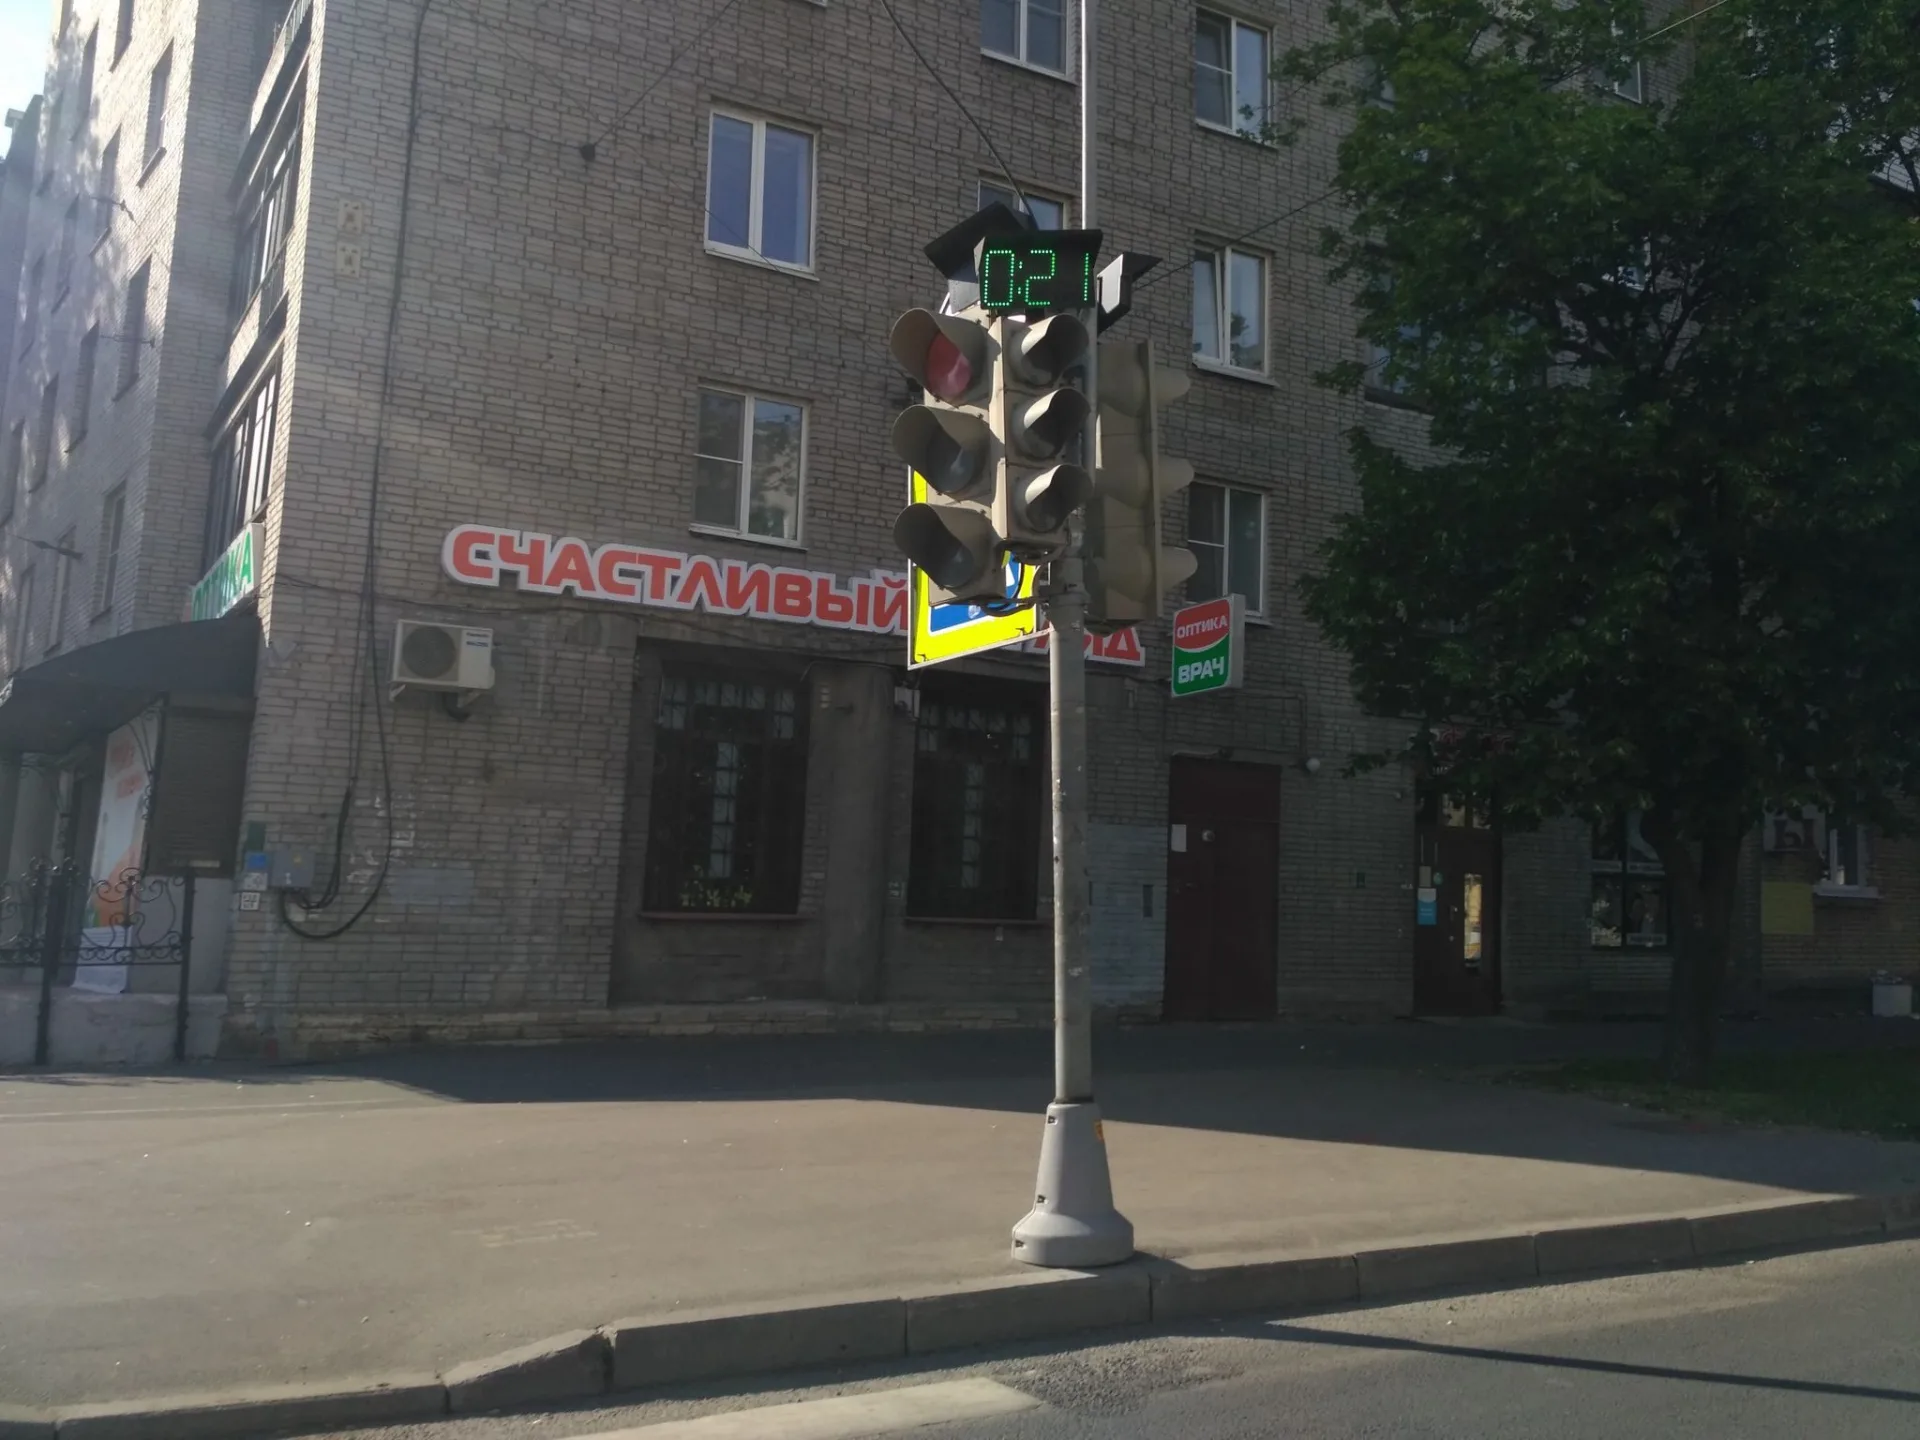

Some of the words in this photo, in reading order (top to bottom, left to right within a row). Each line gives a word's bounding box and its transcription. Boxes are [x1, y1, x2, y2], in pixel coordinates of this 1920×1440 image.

[450, 529, 909, 632] СЧАСТЛИВЫЙ
[1177, 615, 1228, 639] ОПТИКА
[1178, 656, 1225, 684] ВРАЧ
